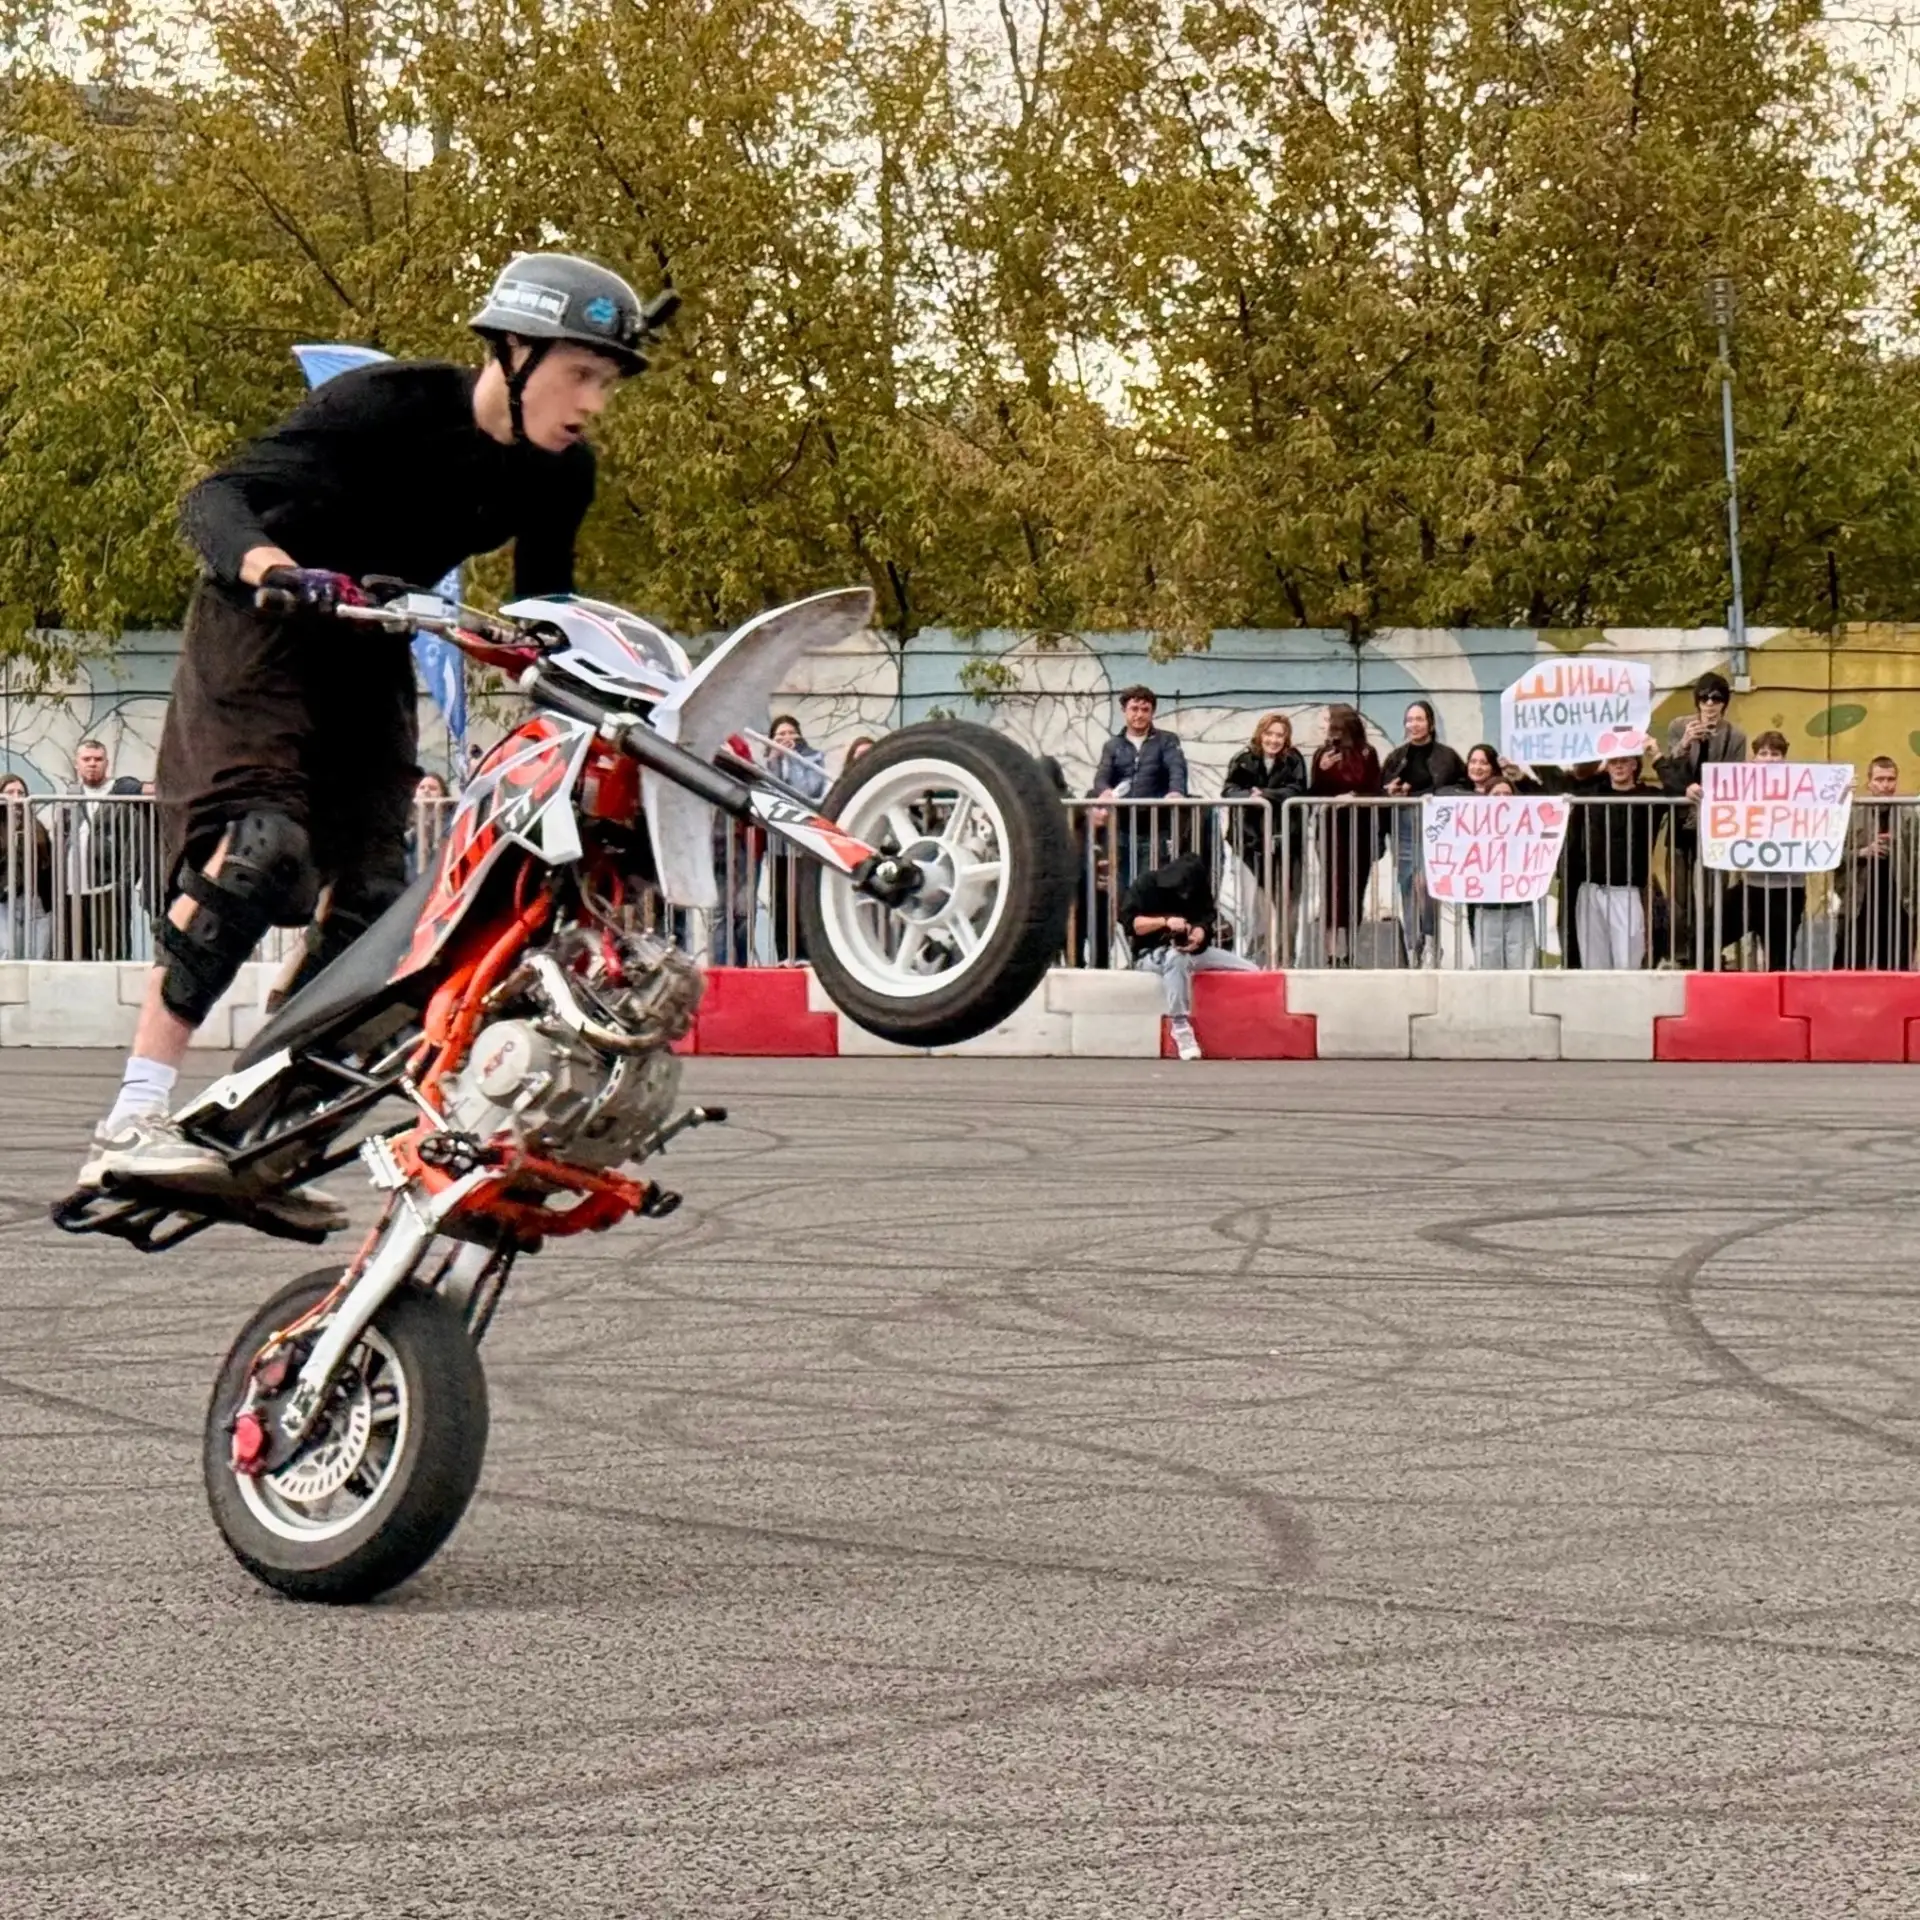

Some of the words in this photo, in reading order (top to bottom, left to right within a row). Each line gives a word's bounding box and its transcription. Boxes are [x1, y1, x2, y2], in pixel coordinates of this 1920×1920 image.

[1515, 665, 1634, 699] ШИША
[1511, 733, 1553, 760] МНЕ
[1560, 732, 1595, 759] НА
[1712, 766, 1816, 801] ШИША
[1454, 801, 1535, 838] КИСА
[1710, 805, 1830, 839] ВЕРНИ
[1429, 836, 1508, 876] ДАЙ
[1523, 841, 1558, 873] ИМ
[1730, 839, 1840, 869] СОТКУ
[1465, 876, 1484, 898] В
[1501, 872, 1548, 900] РОТ
